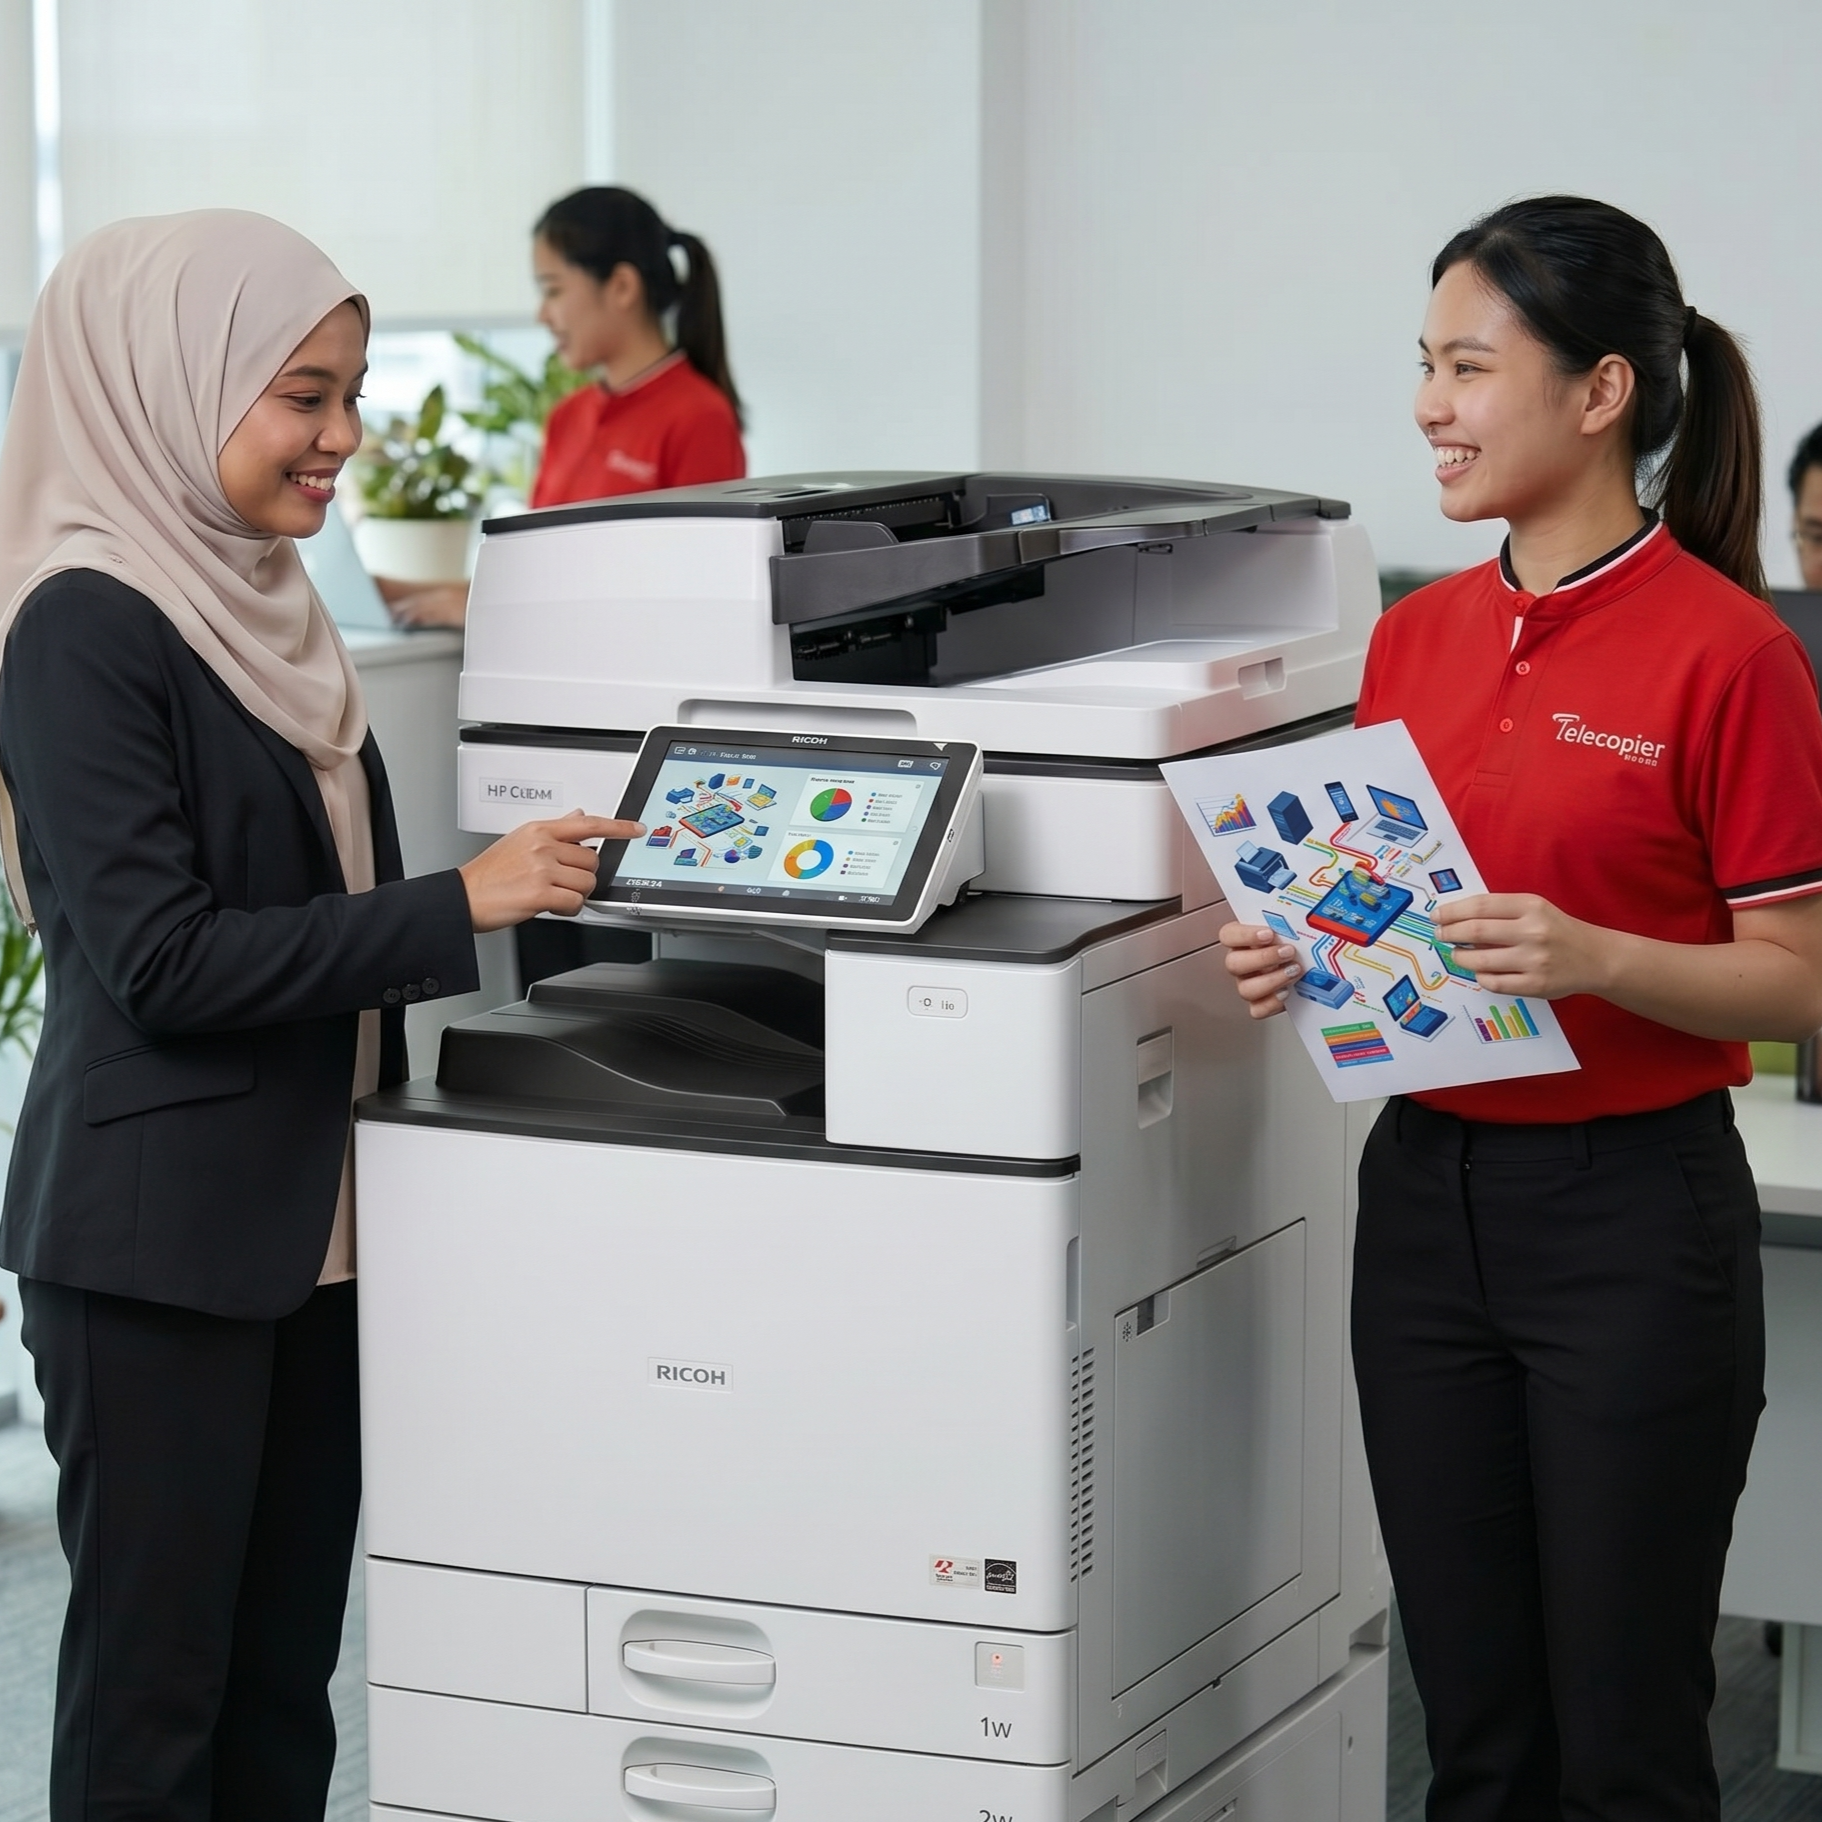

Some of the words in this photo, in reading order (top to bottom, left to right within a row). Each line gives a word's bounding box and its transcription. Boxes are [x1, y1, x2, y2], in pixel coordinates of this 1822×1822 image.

[791, 735, 828, 746] RICOH
[1552, 713, 1666, 759] Telecopier
[487, 784, 507, 797] HP
[656, 1364, 725, 1385] RICOH
